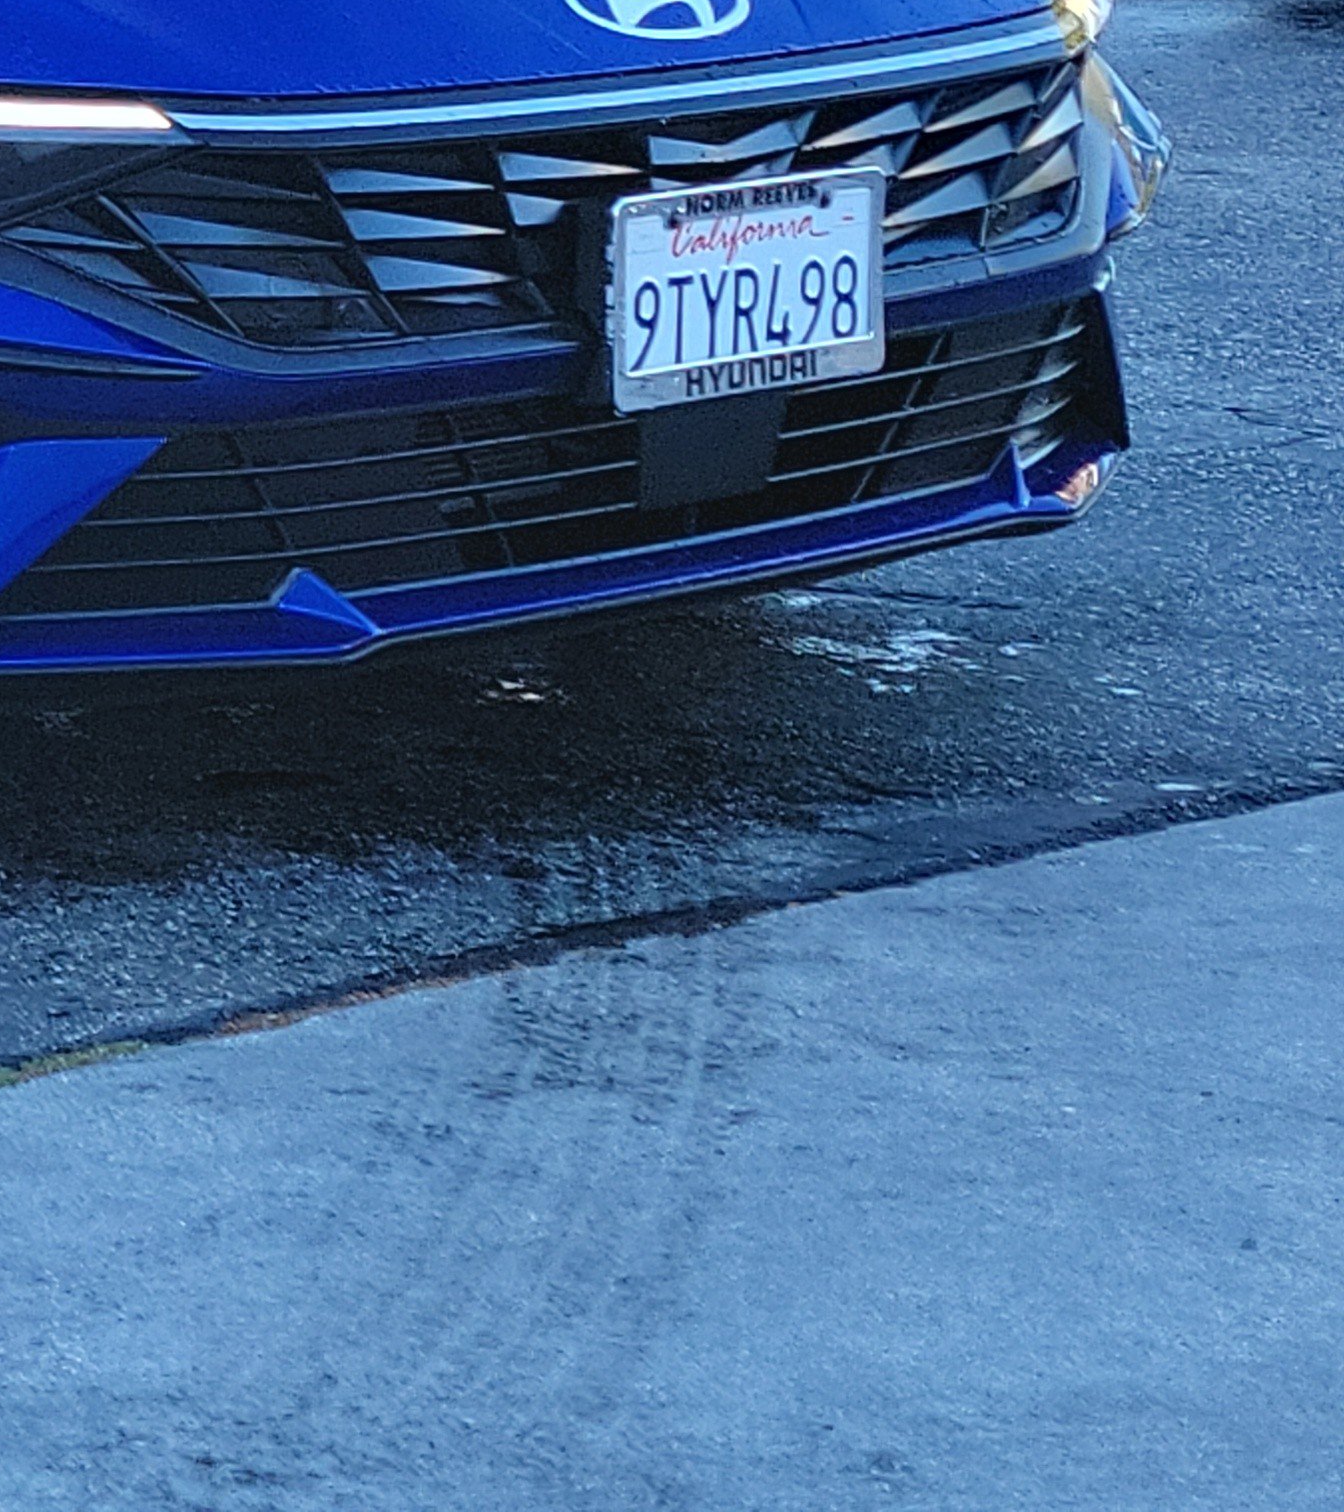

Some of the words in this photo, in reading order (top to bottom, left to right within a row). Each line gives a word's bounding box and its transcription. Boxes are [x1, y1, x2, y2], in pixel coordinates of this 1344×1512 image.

[686, 190, 746, 216] NORM
[672, 214, 829, 265] California
[629, 255, 858, 373] 9TYR498
[686, 350, 818, 397] HYUNDAI
